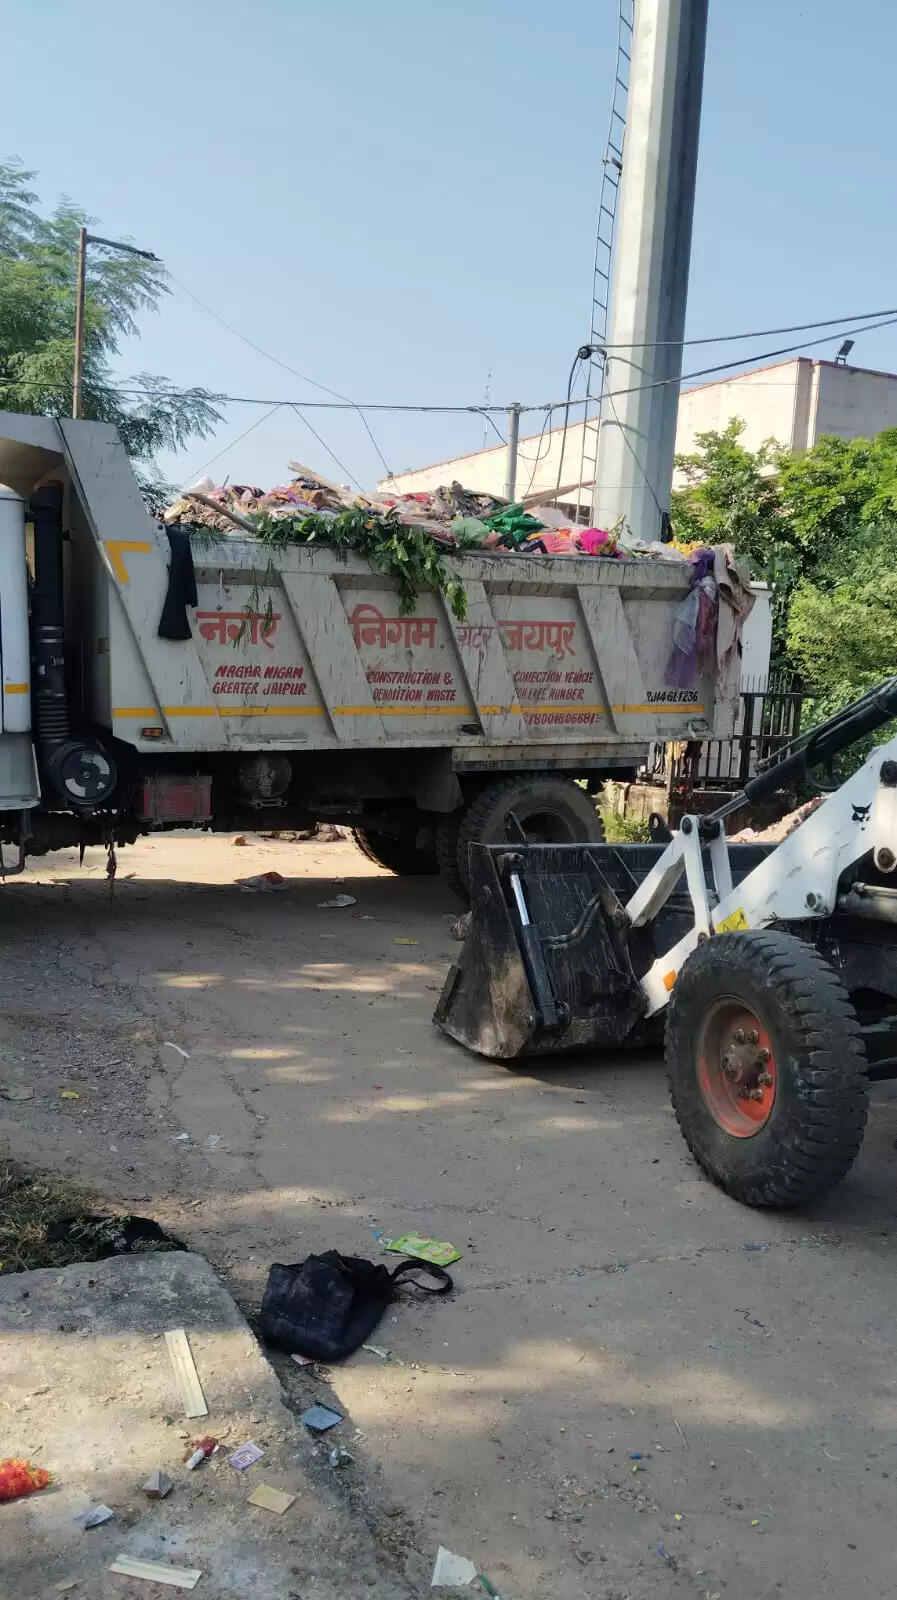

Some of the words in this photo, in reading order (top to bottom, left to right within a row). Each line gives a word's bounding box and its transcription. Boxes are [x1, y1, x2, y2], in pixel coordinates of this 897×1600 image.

[196, 612, 281, 649] नगर
[348, 604, 437, 648] निगम
[498, 620, 576, 661] जयपुर
[215, 665, 262, 678] NAGAR
[264, 666, 304, 679] NIGAM
[443, 671, 453, 685] &
[212, 682, 259, 695] GREATER
[263, 683, 307, 696] JAIPUR
[426, 689, 456, 700] WASTE
[549, 688, 584, 700] NUMBER
